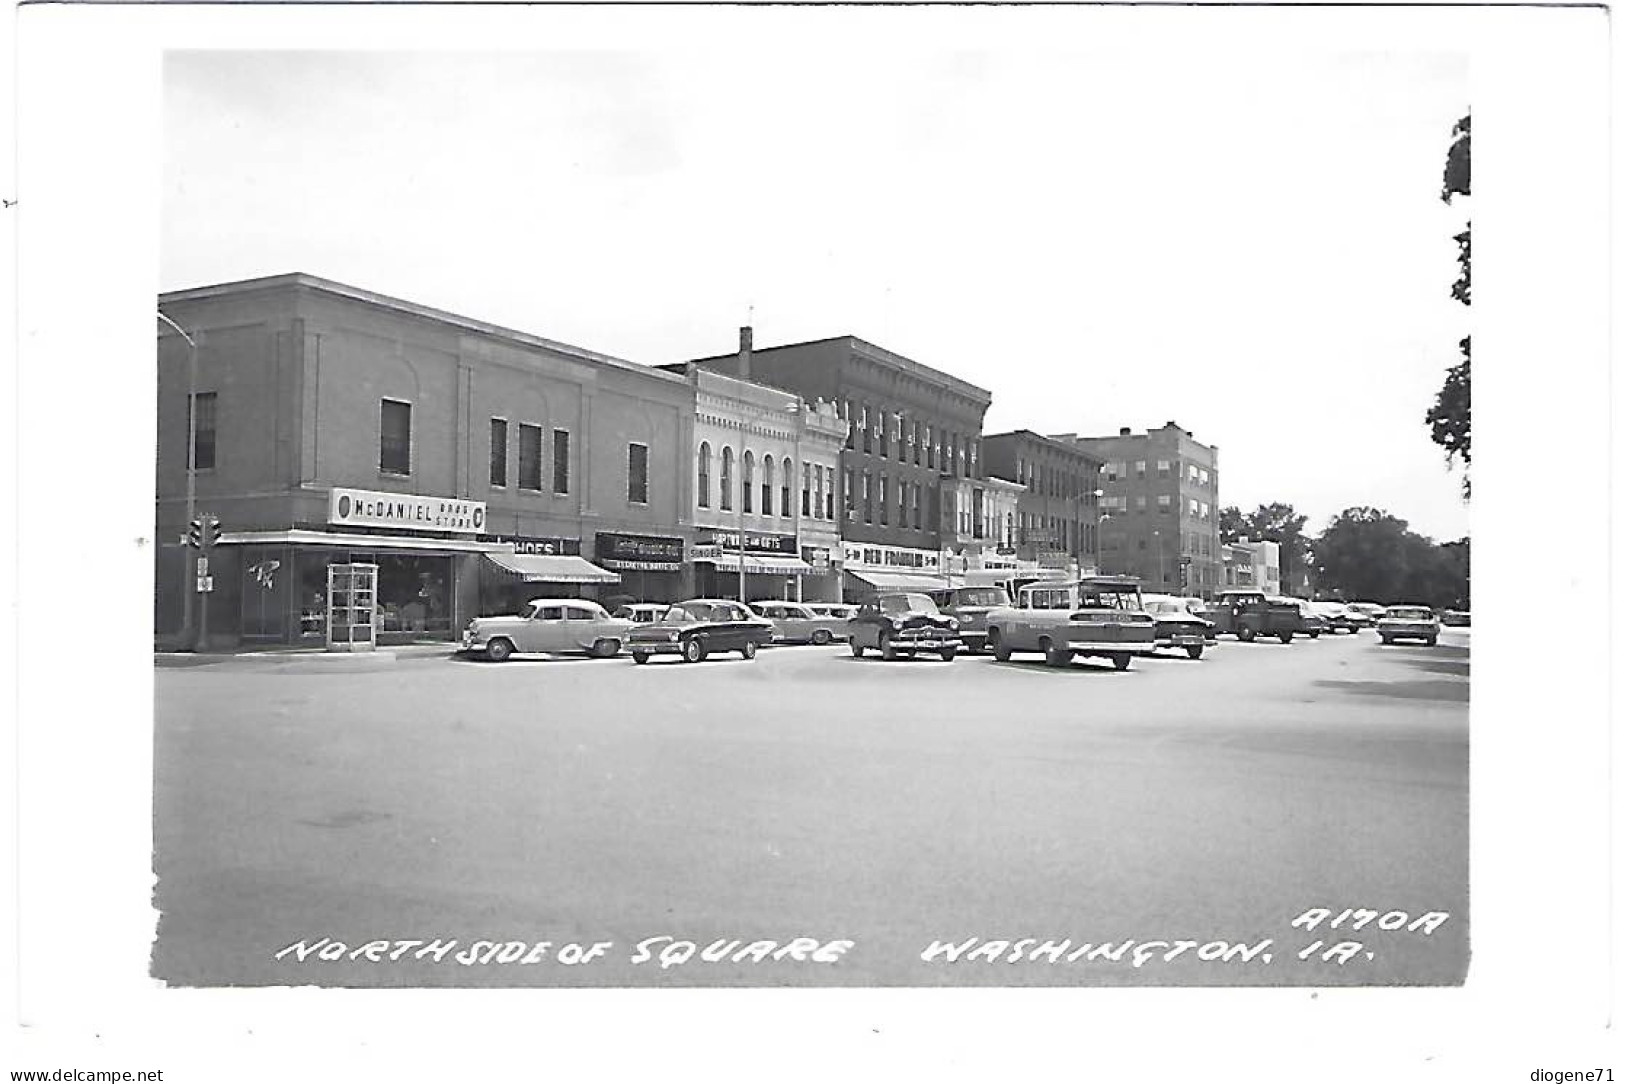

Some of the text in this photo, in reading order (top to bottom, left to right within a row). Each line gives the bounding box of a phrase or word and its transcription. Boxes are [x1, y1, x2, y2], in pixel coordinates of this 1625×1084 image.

[355, 499, 432, 522] McDANIEL
[436, 516, 470, 528] STORE
[506, 541, 554, 555] HOES
[691, 549, 722, 558] SINGER
